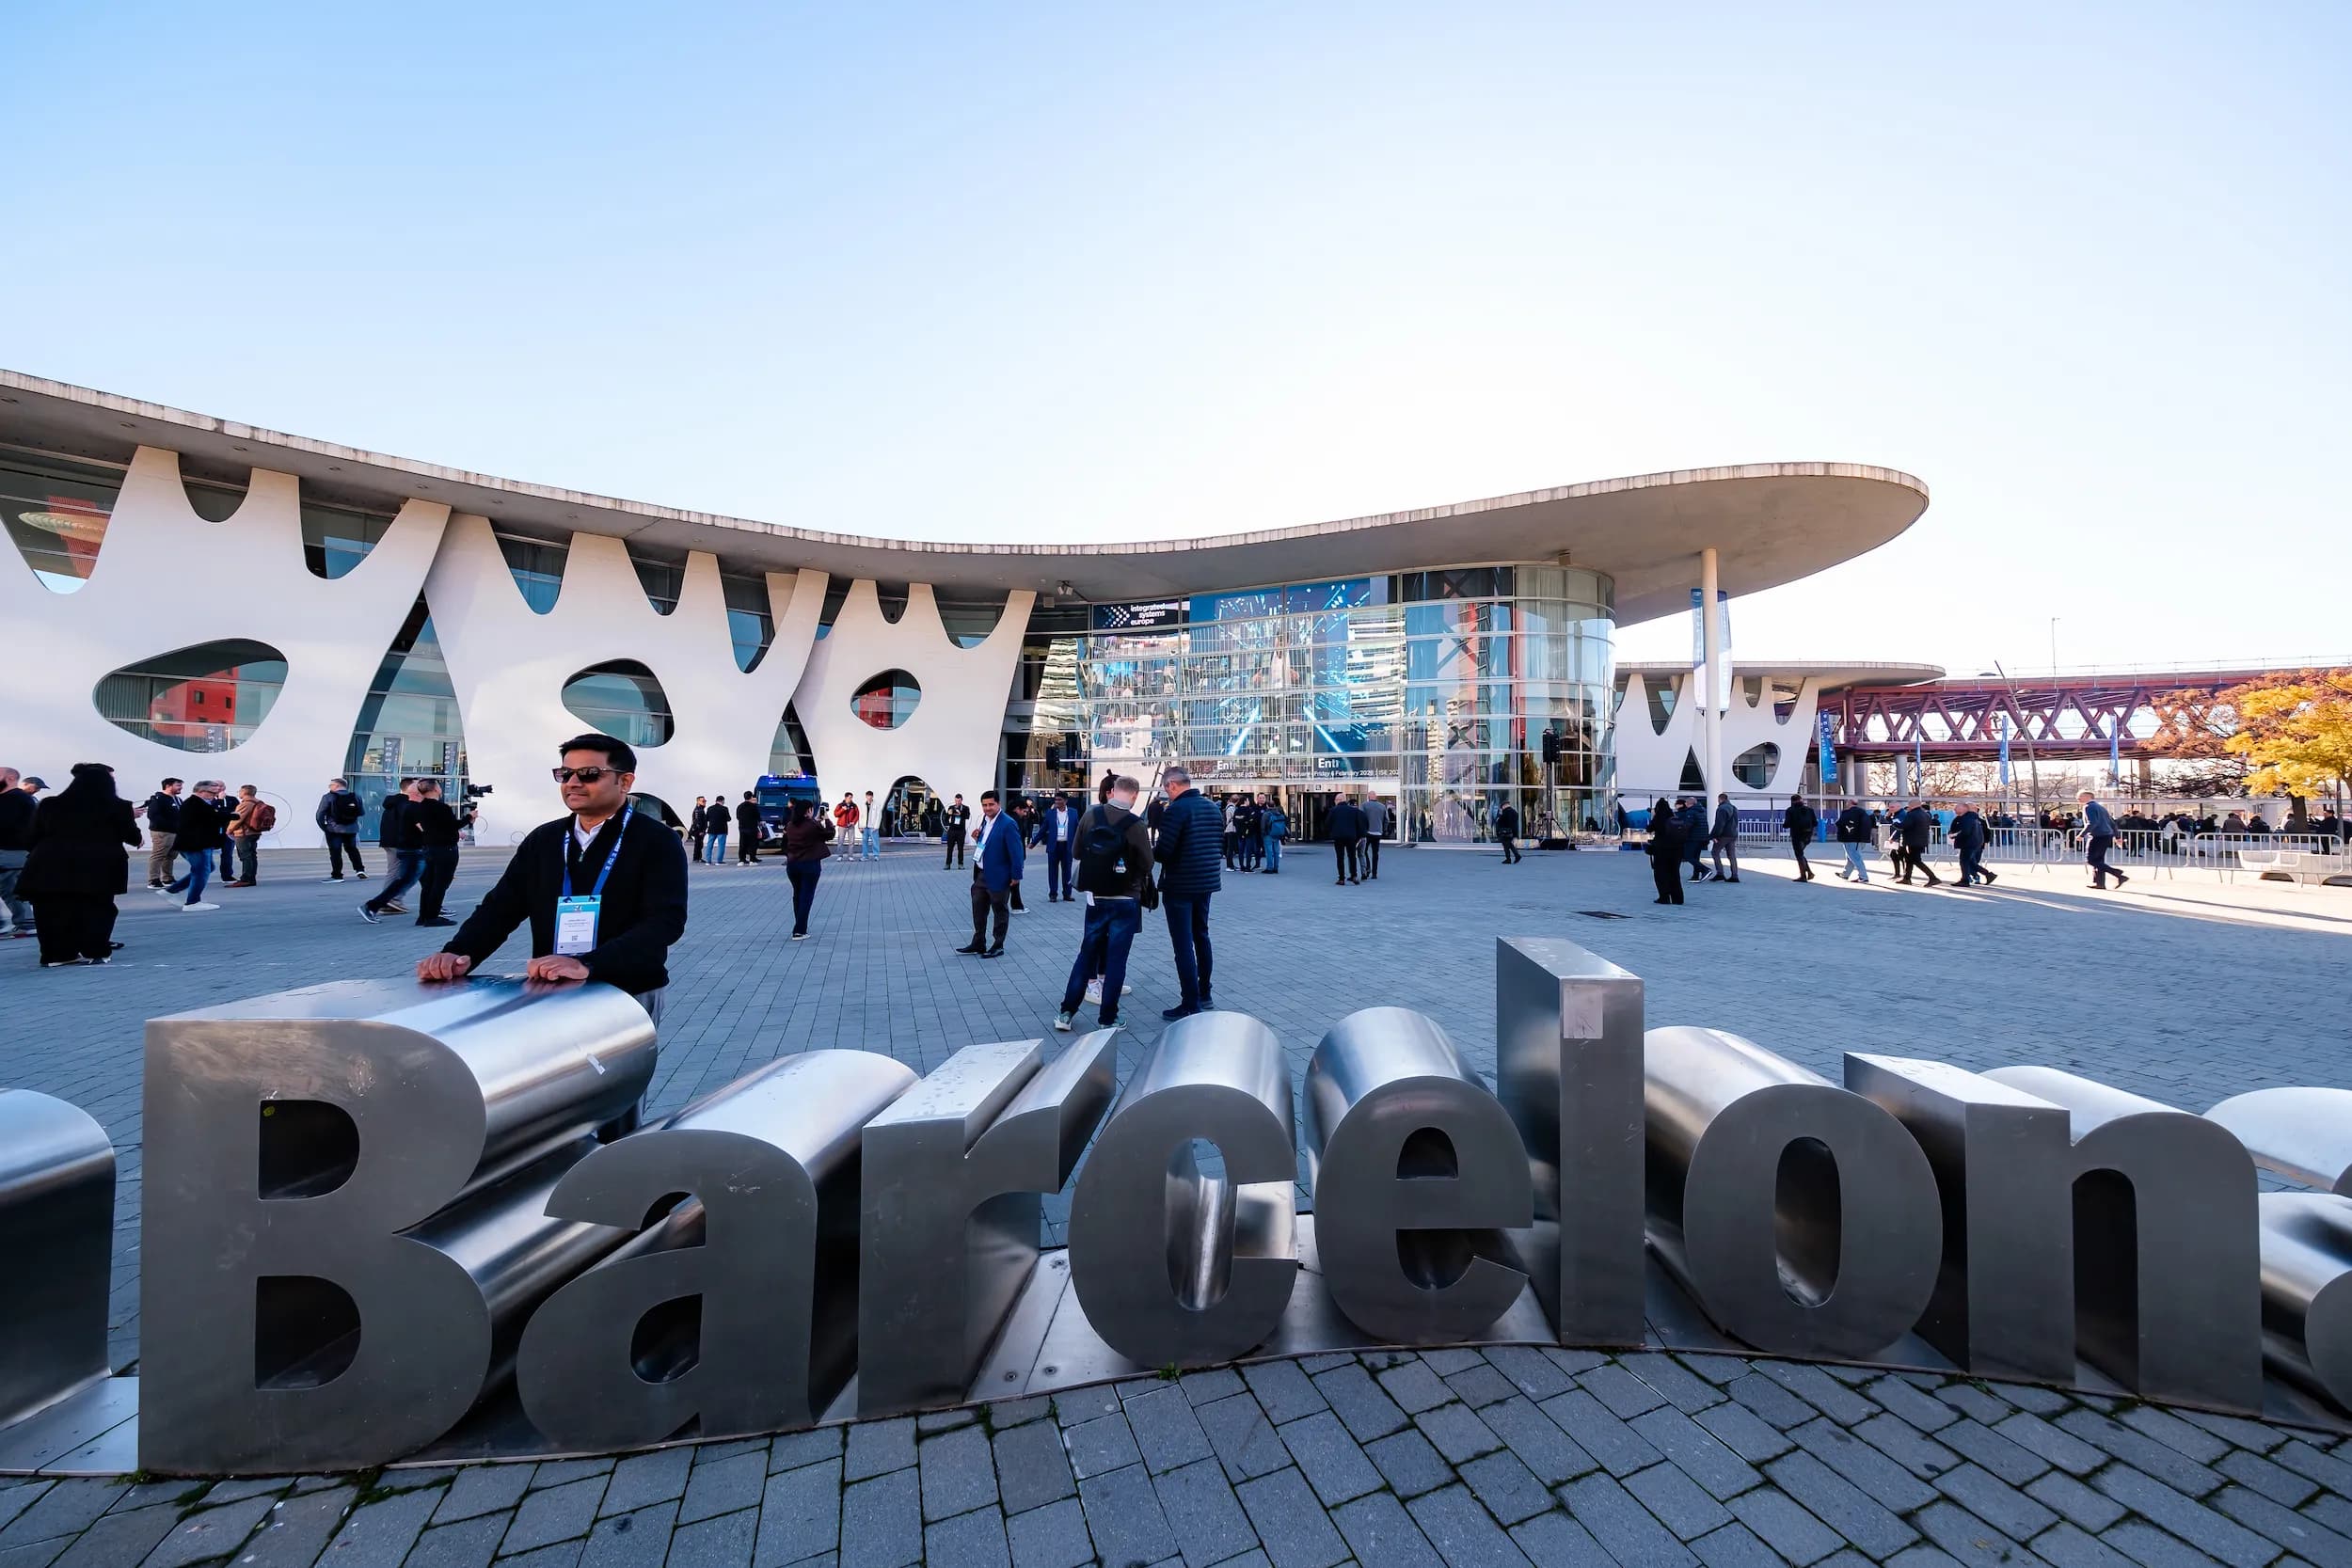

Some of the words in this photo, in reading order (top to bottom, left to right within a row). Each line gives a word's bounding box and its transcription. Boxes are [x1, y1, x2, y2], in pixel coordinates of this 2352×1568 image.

[1130, 603, 1166, 611] integrated
[1138, 610, 1166, 619] systems
[139, 941, 2352, 1477] Barcelon
